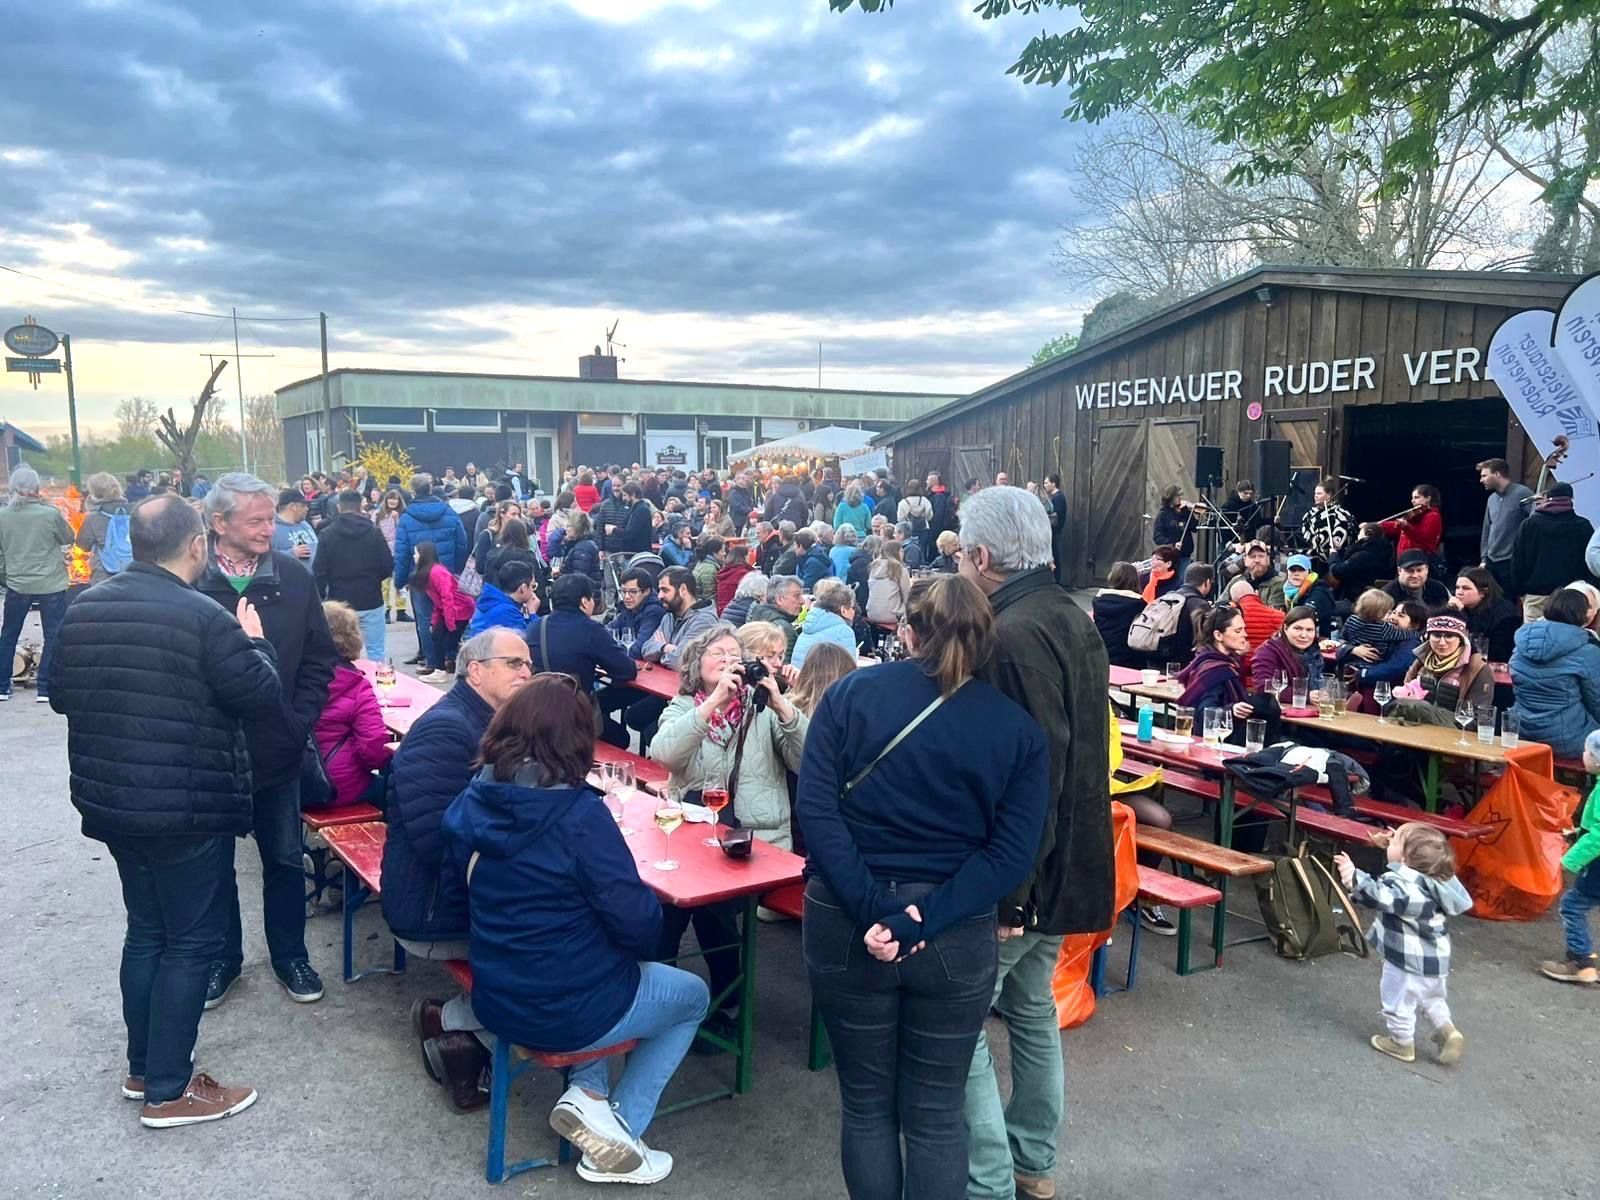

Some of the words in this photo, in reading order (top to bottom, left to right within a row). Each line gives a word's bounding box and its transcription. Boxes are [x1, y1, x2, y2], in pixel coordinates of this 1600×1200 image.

[1075, 369, 1242, 410] WEISENAUER
[1264, 357, 1376, 397] RUDER
[1403, 347, 1495, 386] VER
